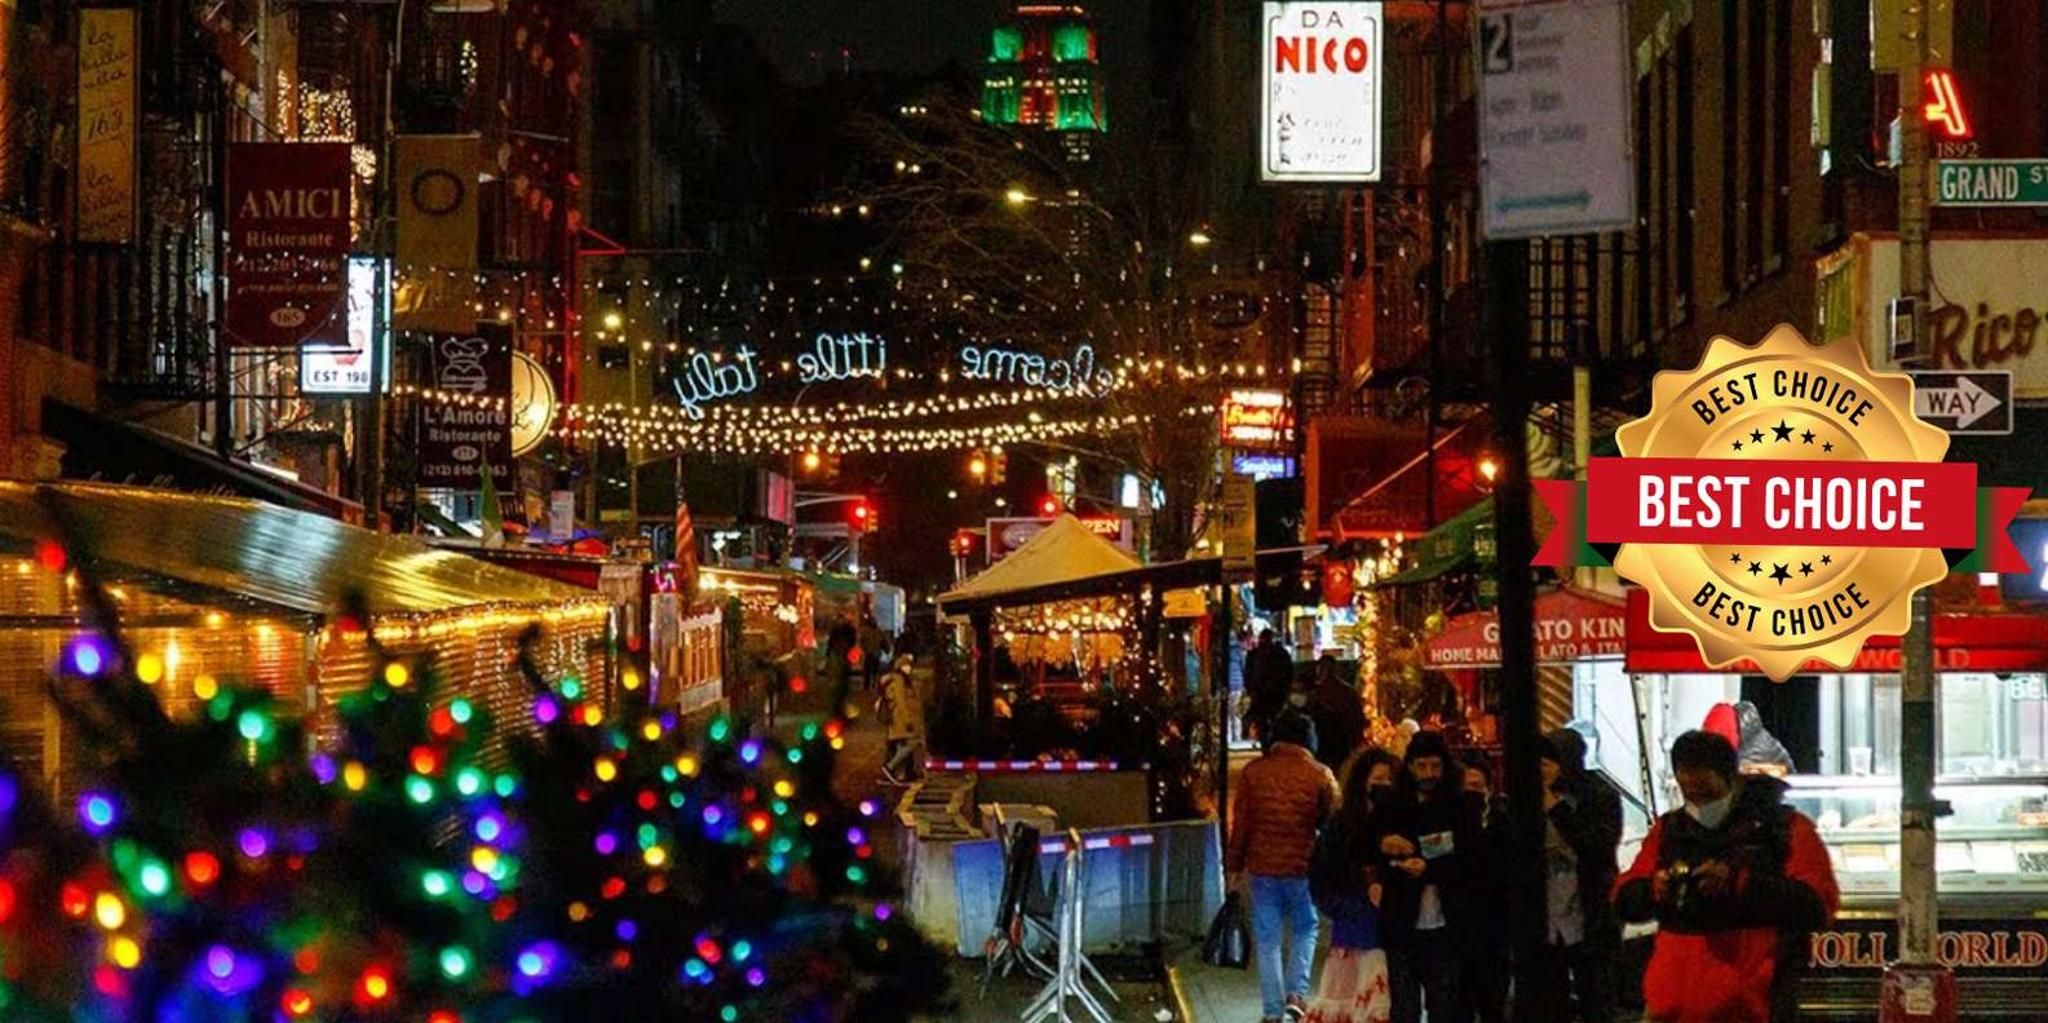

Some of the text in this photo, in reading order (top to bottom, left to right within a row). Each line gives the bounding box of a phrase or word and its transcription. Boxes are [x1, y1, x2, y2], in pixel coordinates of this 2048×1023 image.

[1302, 9, 1344, 29] DA
[1275, 36, 1369, 74] NICO
[1936, 142, 1981, 158] 1892
[1942, 166, 2019, 200] GRAND
[239, 188, 341, 219] AMICI
[246, 231, 334, 247] Ristorante
[313, 370, 338, 382] EST
[1927, 391, 1982, 413] WAY
[1081, 519, 1121, 533] PEN
[1483, 617, 1626, 643] GATO KIN
[1432, 649, 1473, 662] HOME
[1597, 641, 1626, 654] ITA
[1861, 649, 1971, 670] WOLD
[1937, 931, 2048, 968] ORLD
